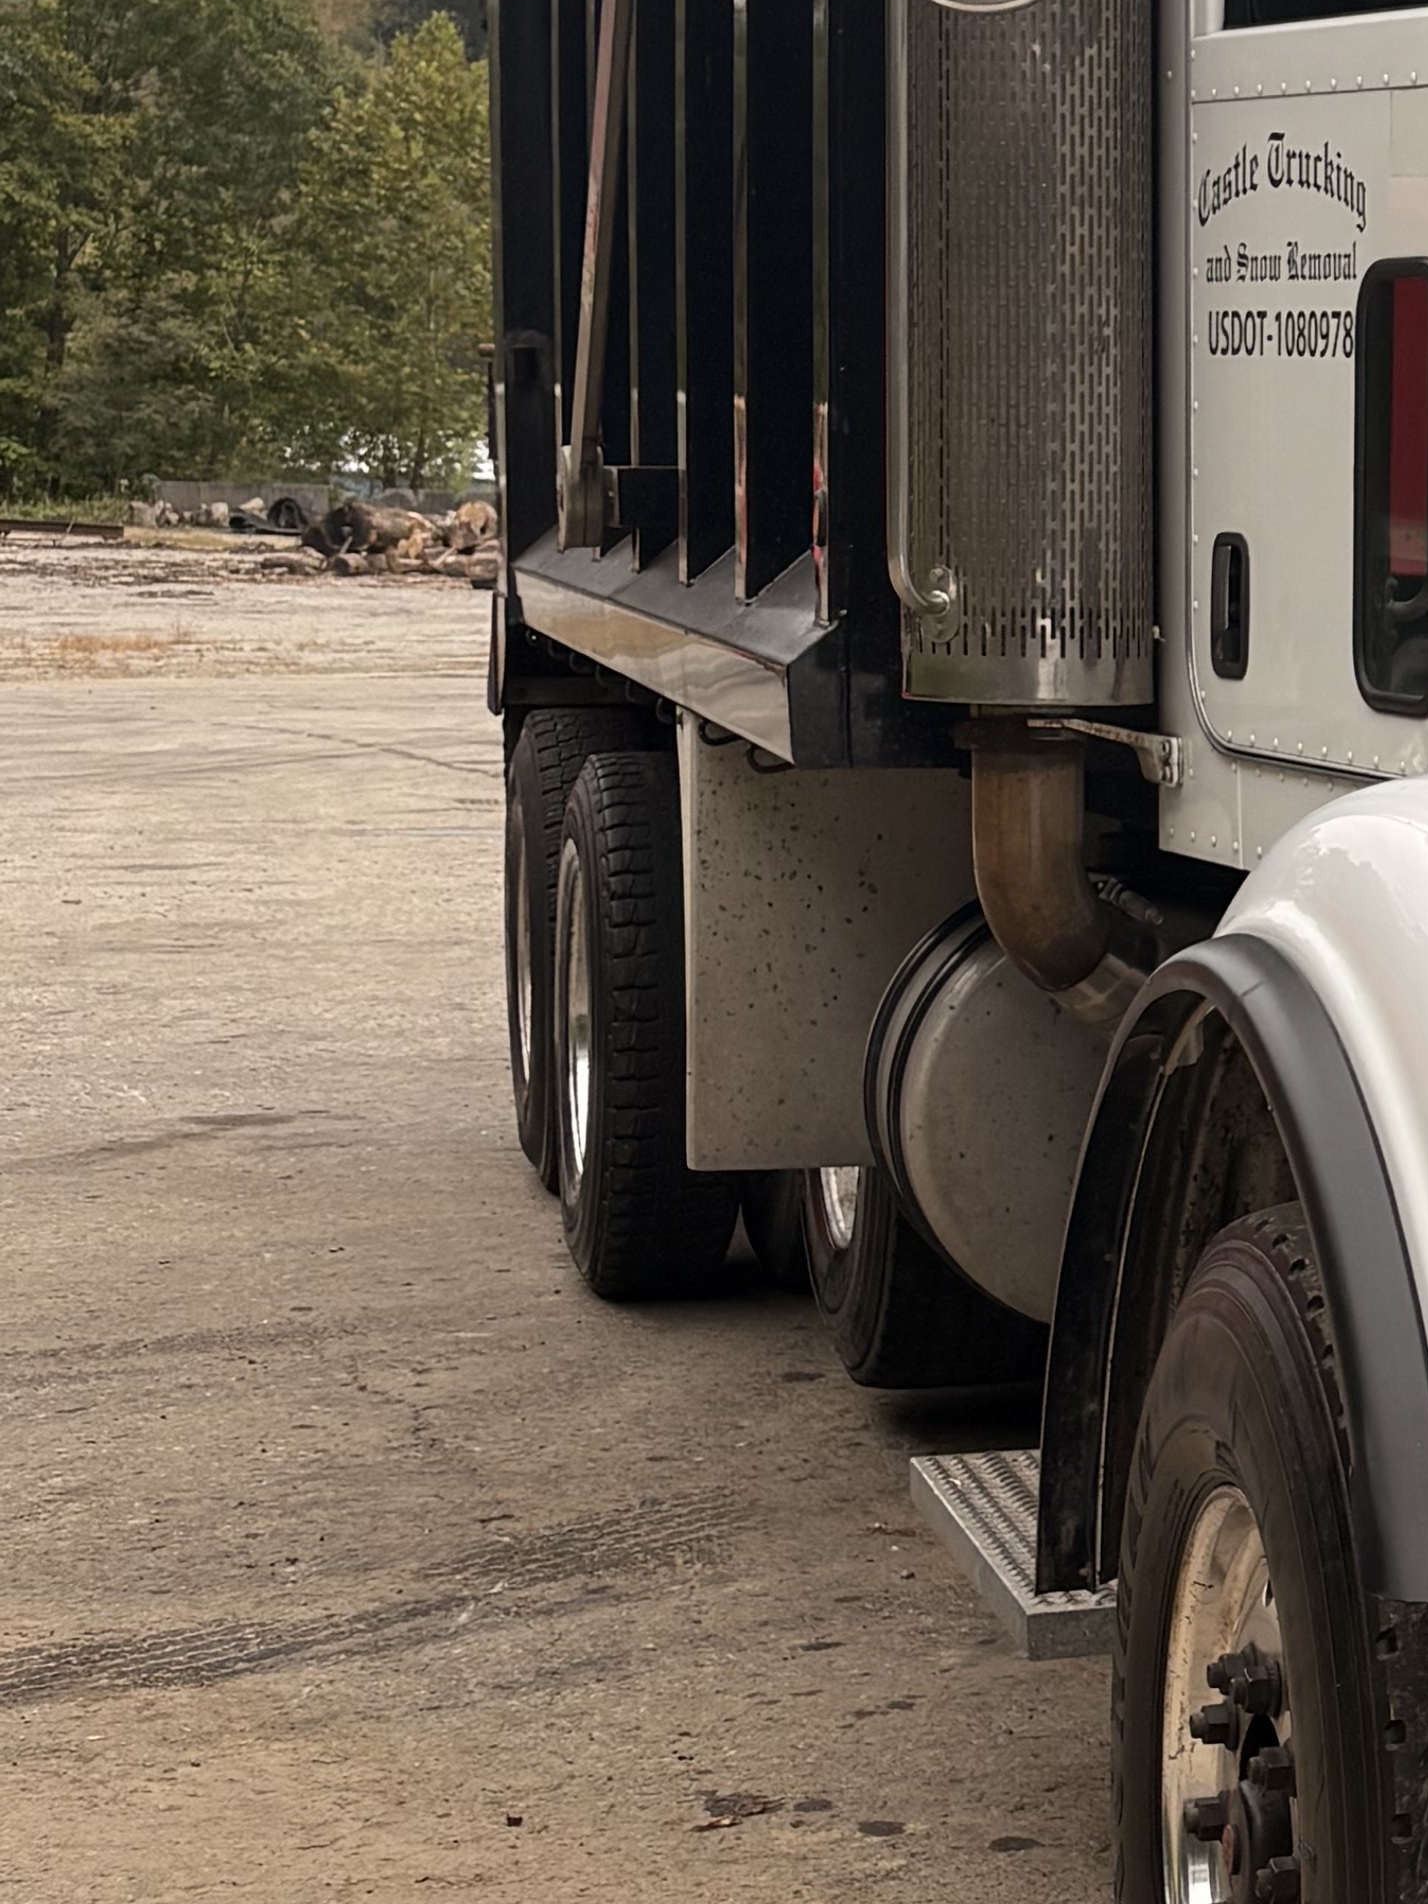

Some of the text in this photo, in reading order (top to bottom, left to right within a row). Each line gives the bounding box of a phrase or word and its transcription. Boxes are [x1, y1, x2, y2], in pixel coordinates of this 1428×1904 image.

[1198, 131, 1367, 234] Castle Trucking
[1206, 240, 1358, 283] and Snow Removal
